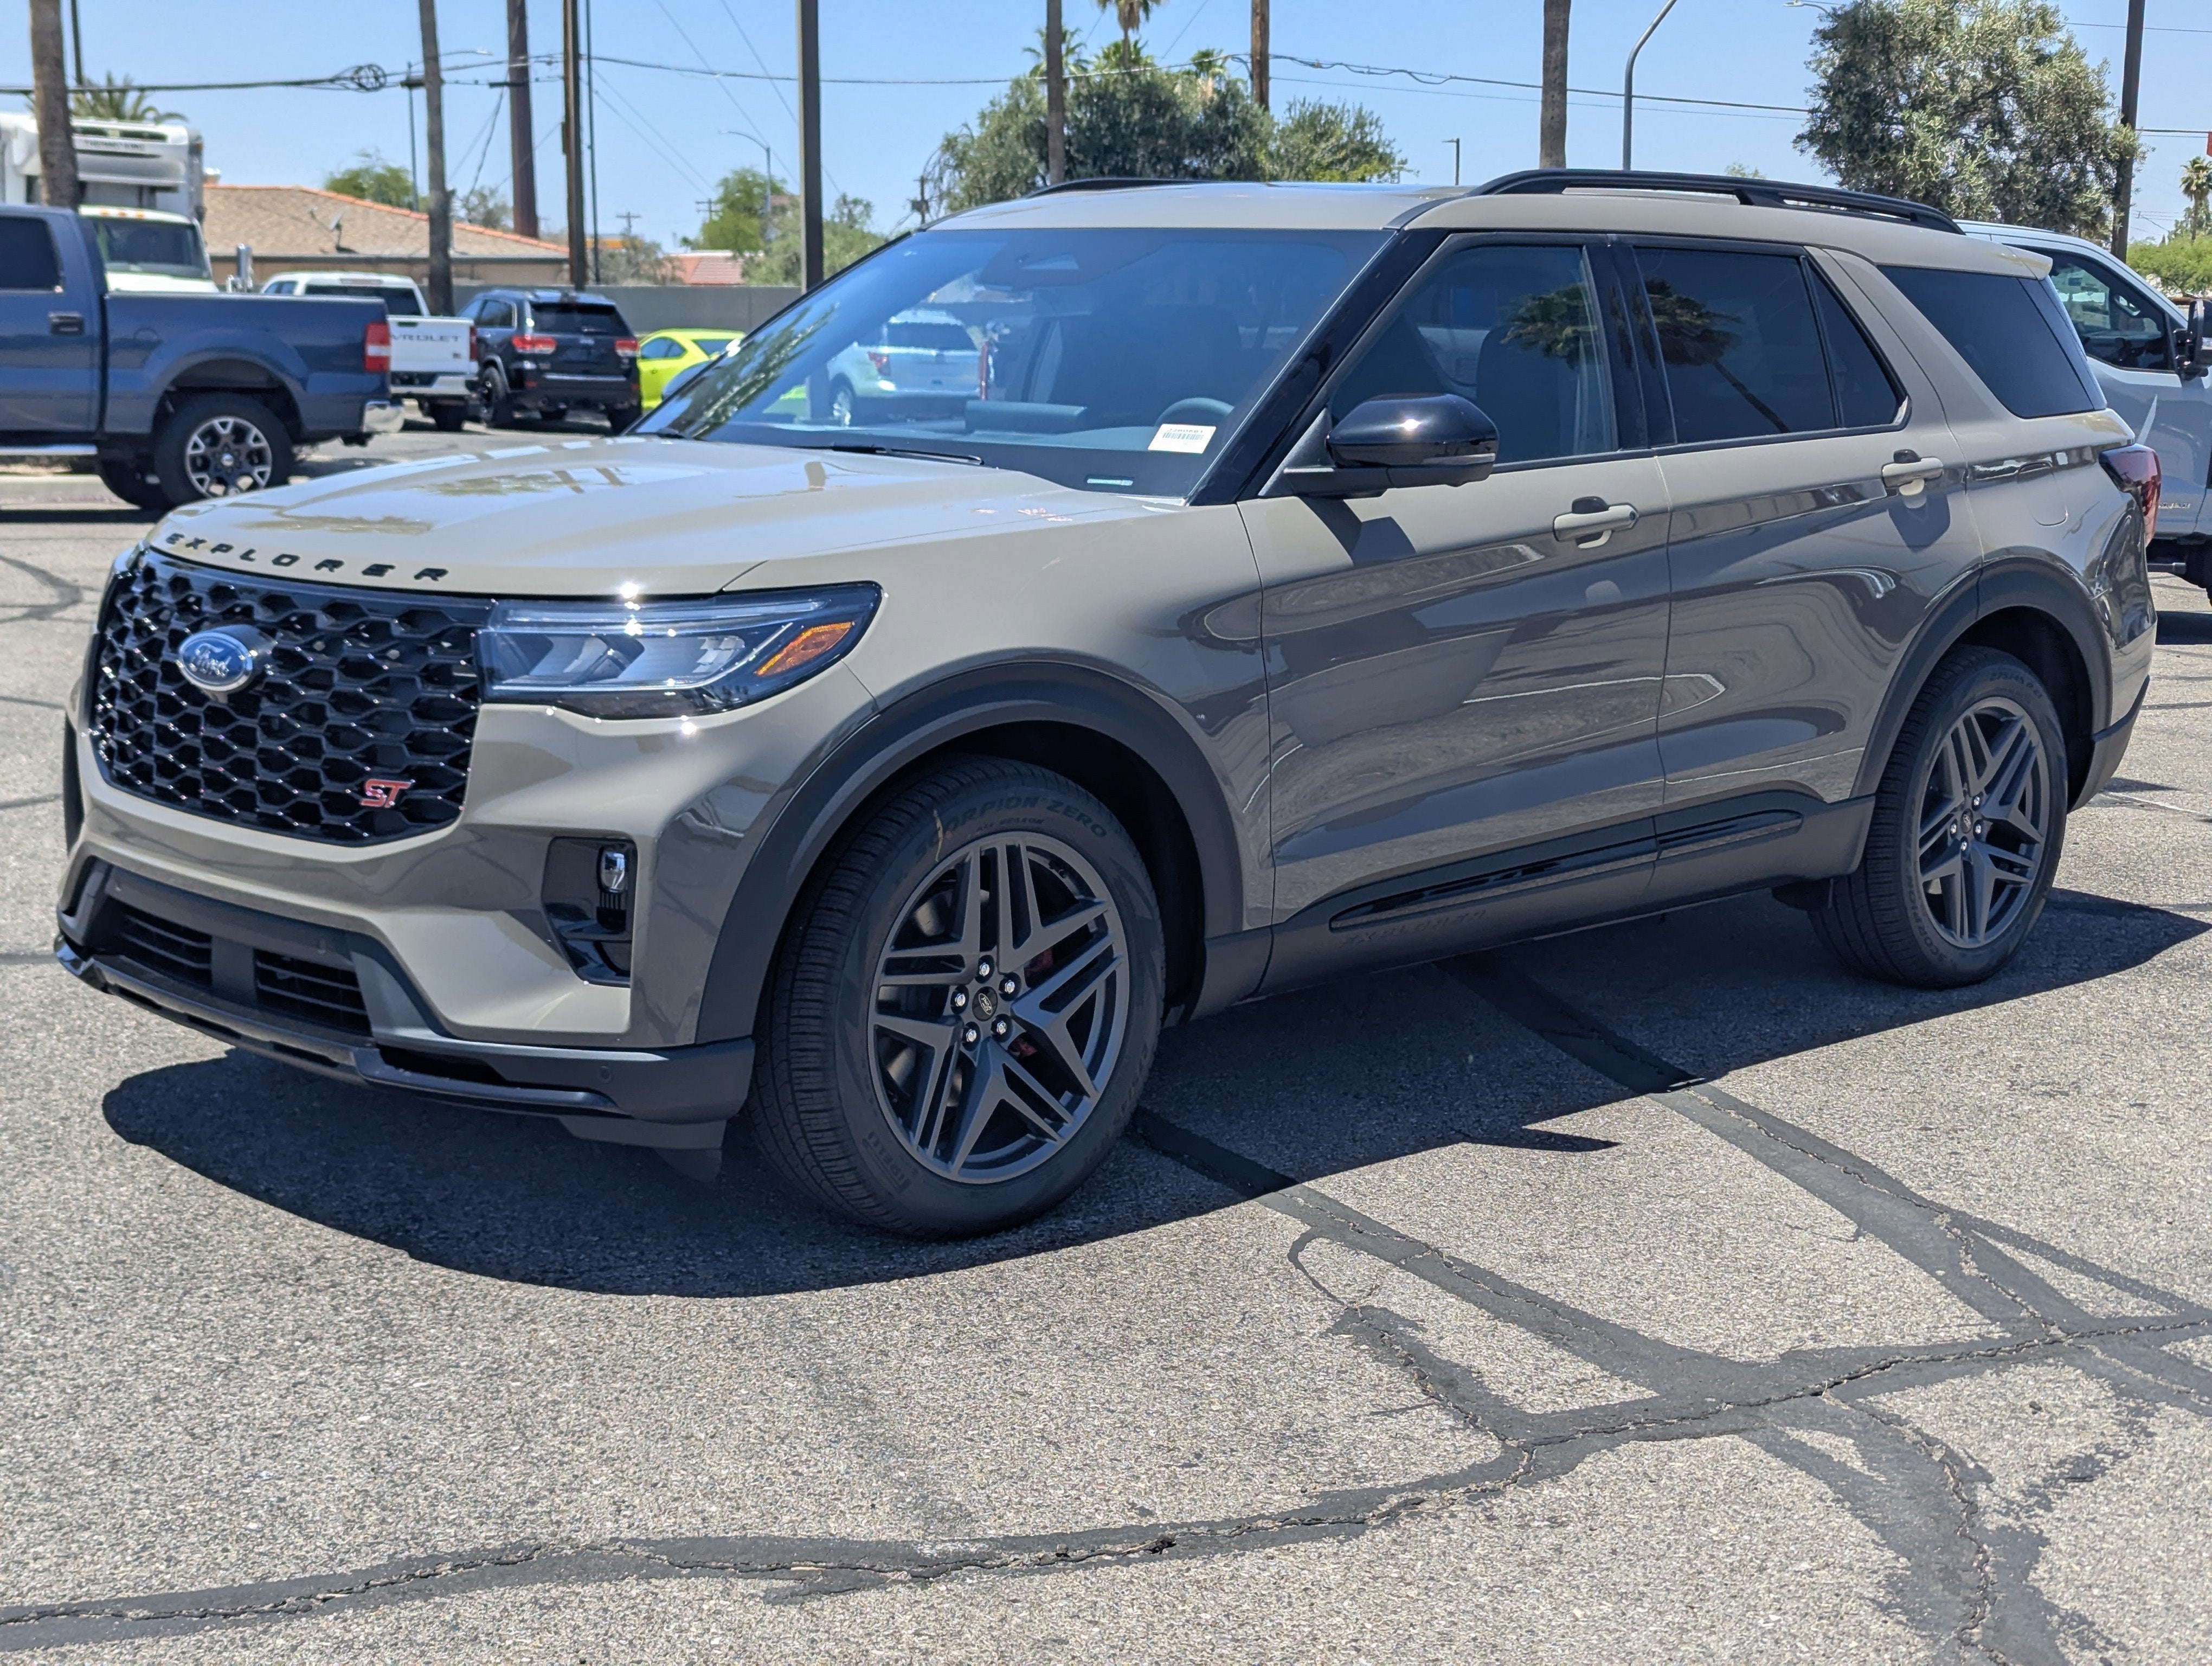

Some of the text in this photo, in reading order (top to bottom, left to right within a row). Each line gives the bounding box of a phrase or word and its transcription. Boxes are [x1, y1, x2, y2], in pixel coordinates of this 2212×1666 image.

[166, 533, 449, 581] EXPLORER
[360, 778, 411, 808] ST
[1043, 798, 1107, 837] ZERO
